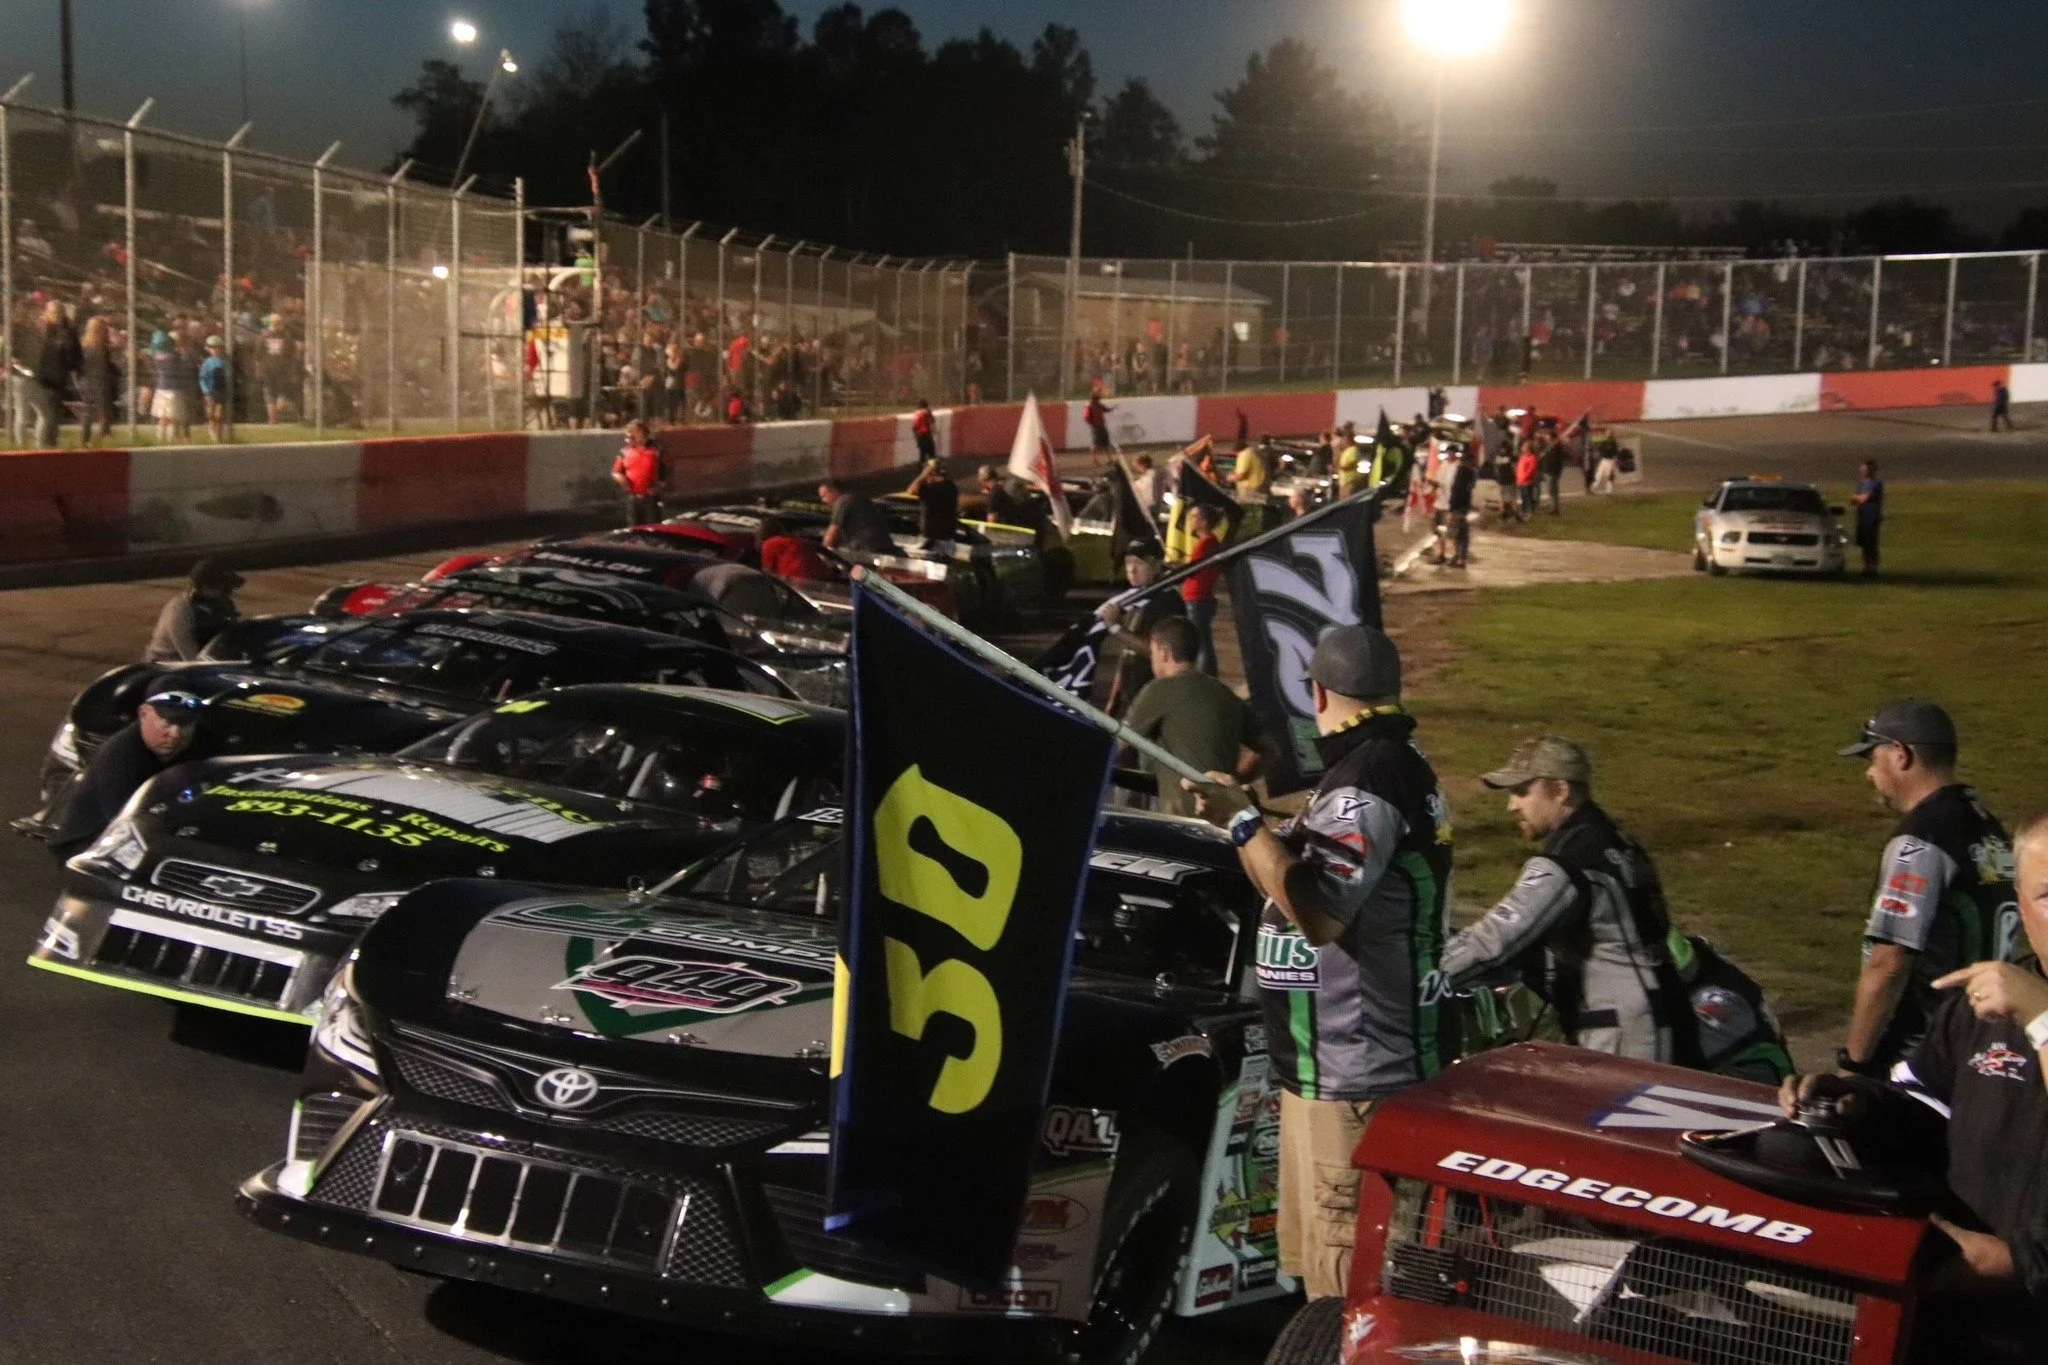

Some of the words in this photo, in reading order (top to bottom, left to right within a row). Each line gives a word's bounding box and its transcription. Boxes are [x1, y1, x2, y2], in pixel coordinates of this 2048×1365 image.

[224, 799, 432, 848] 893-1135
[398, 811, 512, 853] Repairs
[121, 885, 262, 931] CHEVROLET
[1045, 1108, 1117, 1151] QA1
[1437, 1150, 1813, 1244] EDGECOMB
